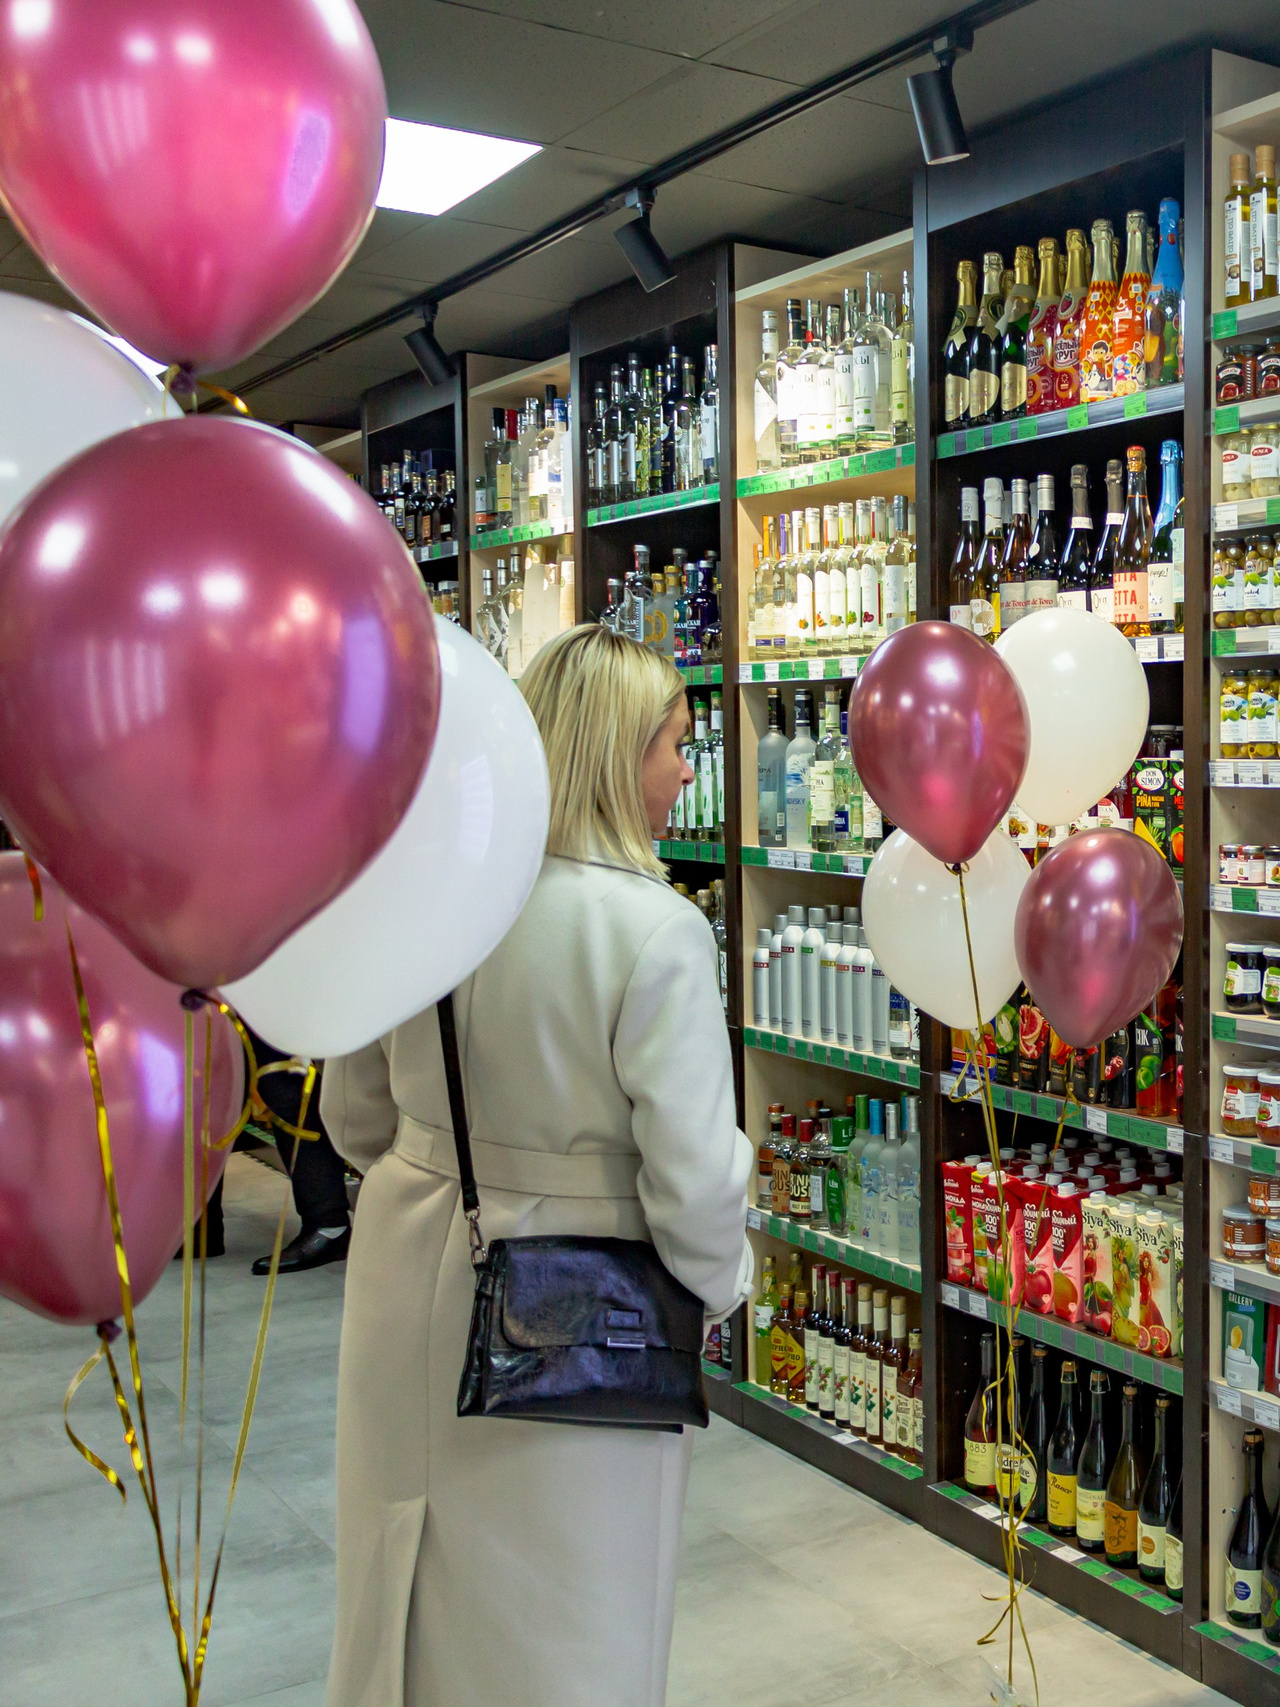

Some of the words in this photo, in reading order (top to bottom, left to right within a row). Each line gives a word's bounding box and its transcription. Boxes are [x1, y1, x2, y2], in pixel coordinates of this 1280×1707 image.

[1136, 794, 1151, 807] PIÑA
[1082, 1211, 1103, 1228] Siya
[986, 1225, 997, 1234] СОК
[1109, 1219, 1132, 1237] Siya
[1137, 1228, 1157, 1246] Siya
[1229, 1292, 1253, 1307] GALLERY
